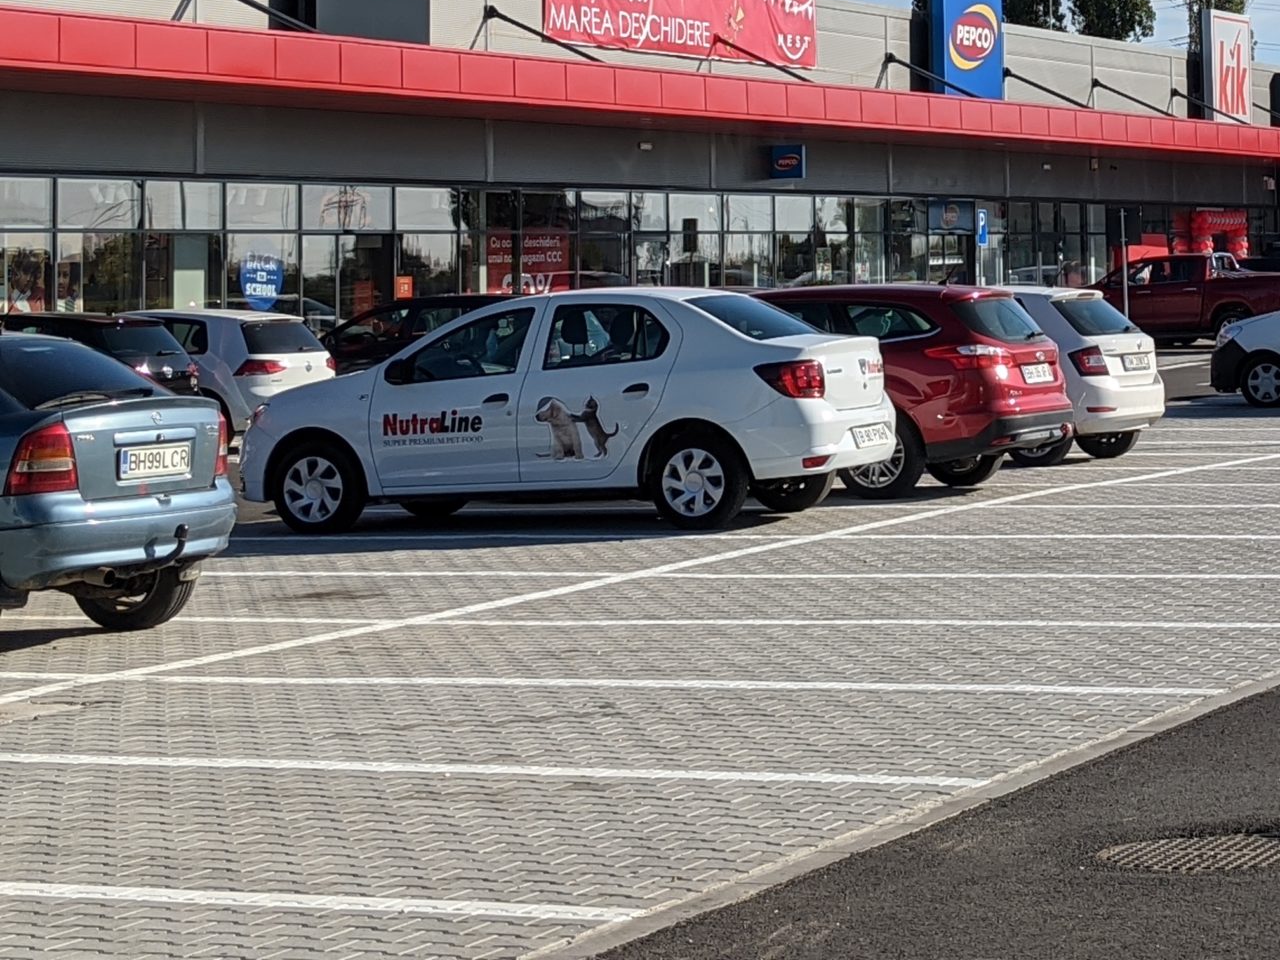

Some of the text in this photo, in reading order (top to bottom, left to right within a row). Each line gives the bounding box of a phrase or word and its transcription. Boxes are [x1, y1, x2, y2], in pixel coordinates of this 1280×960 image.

[549, 3, 711, 48] MAREA DESCHIDERE
[956, 24, 991, 49] PEPCO
[979, 213, 986, 235] P
[546, 251, 562, 263] CCC
[245, 282, 278, 297] SCHOOL
[382, 409, 483, 437] NutraLine
[382, 438, 409, 448] SUPER
[409, 437, 444, 446] PREMIUM
[461, 435, 484, 444] FOOD
